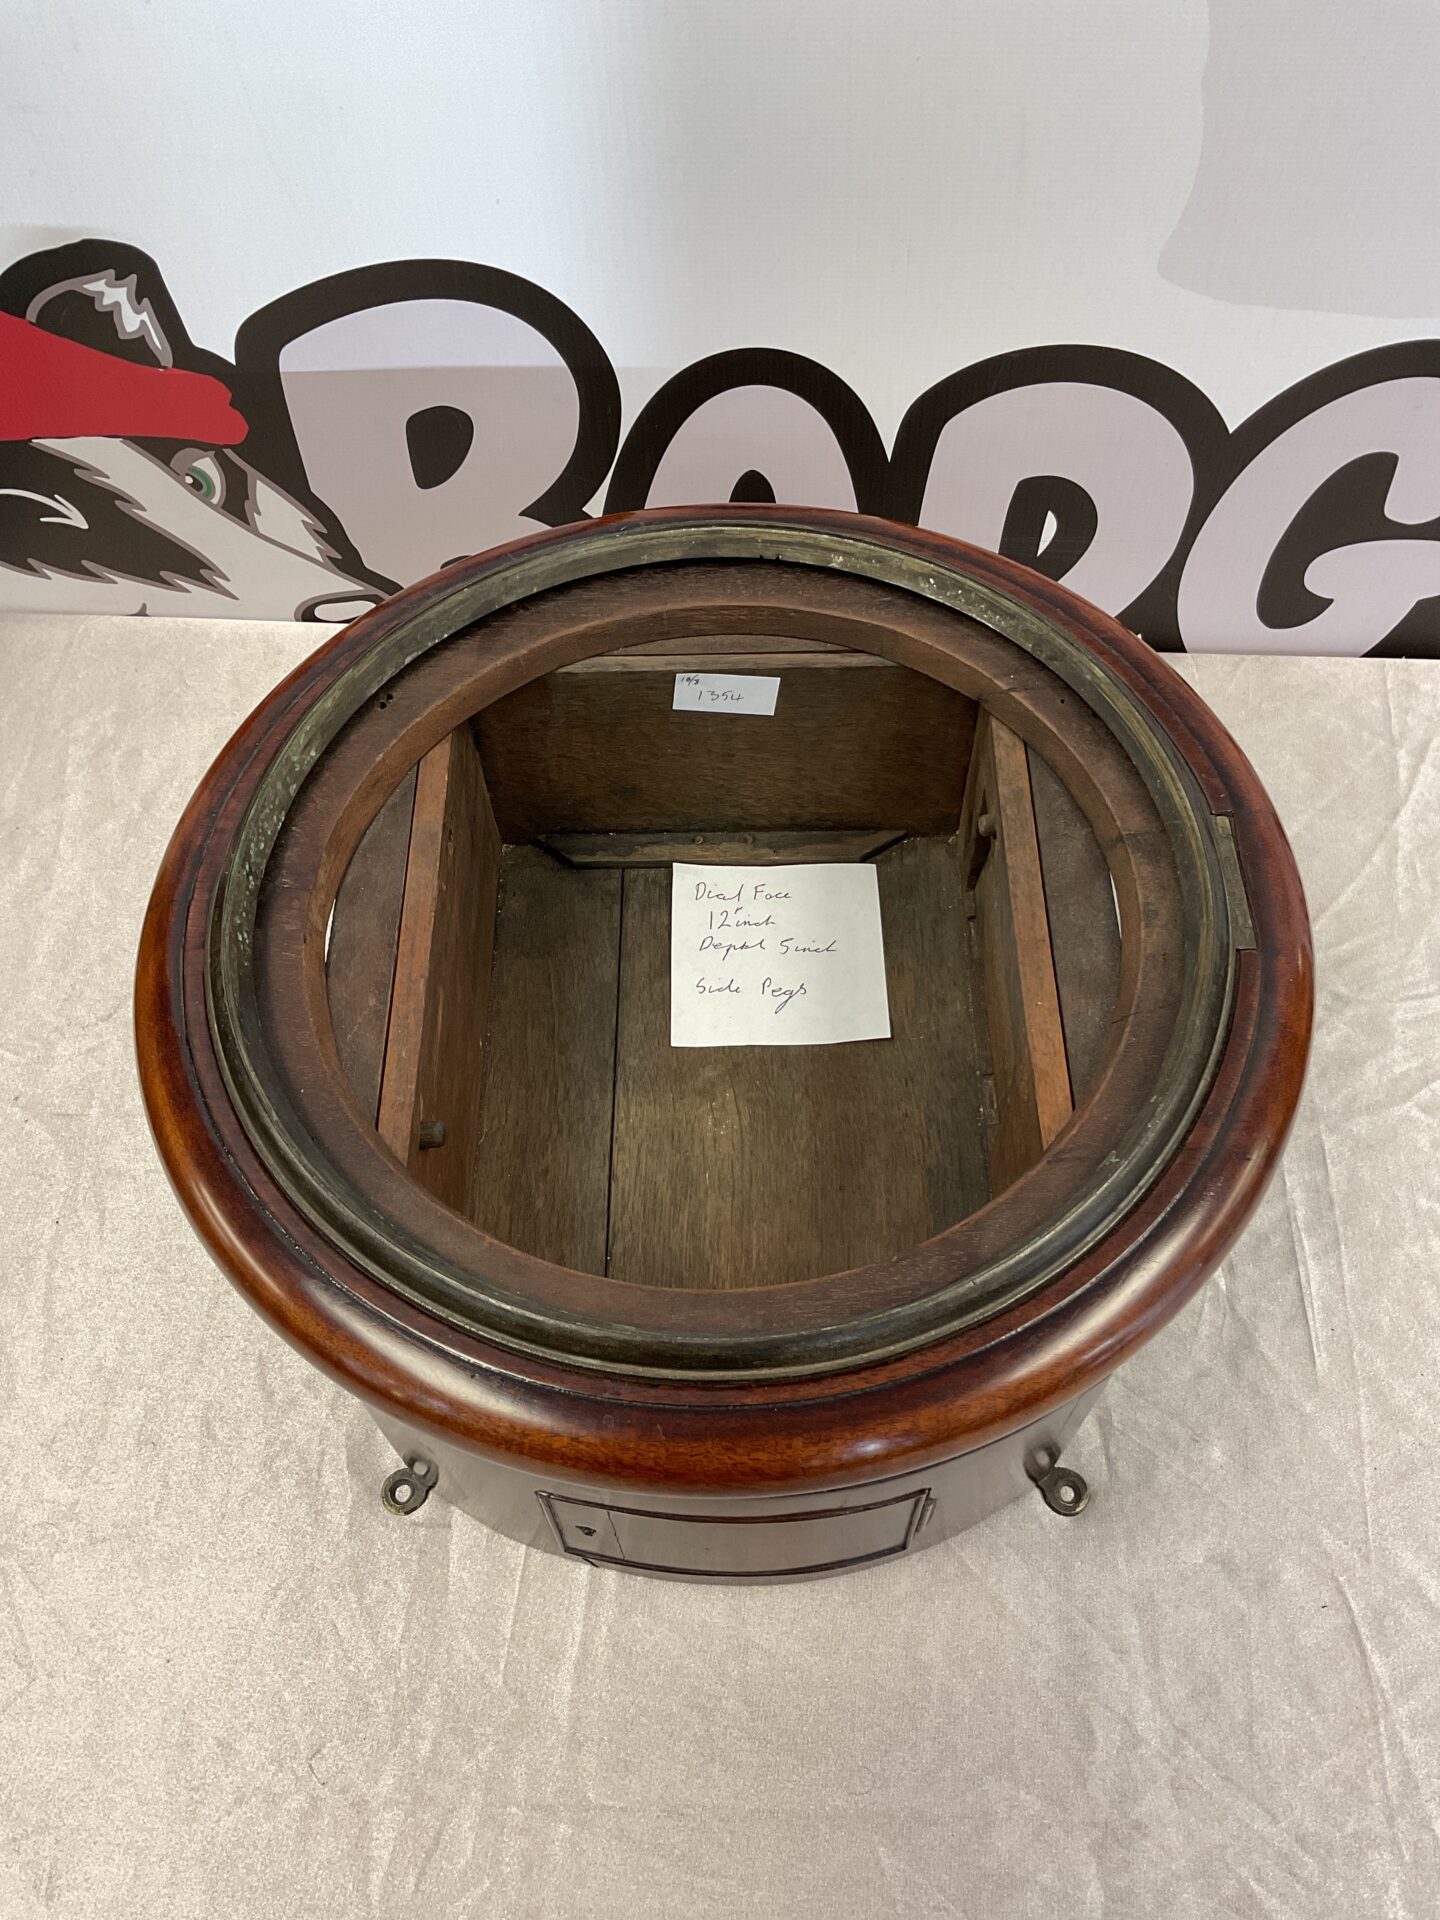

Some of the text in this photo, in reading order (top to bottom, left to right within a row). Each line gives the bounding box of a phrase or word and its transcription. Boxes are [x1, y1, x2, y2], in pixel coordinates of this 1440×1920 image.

[698, 690, 744, 701] 1354
[695, 881, 792, 903] Dial Face
[695, 976, 807, 1014] Side Pegs
